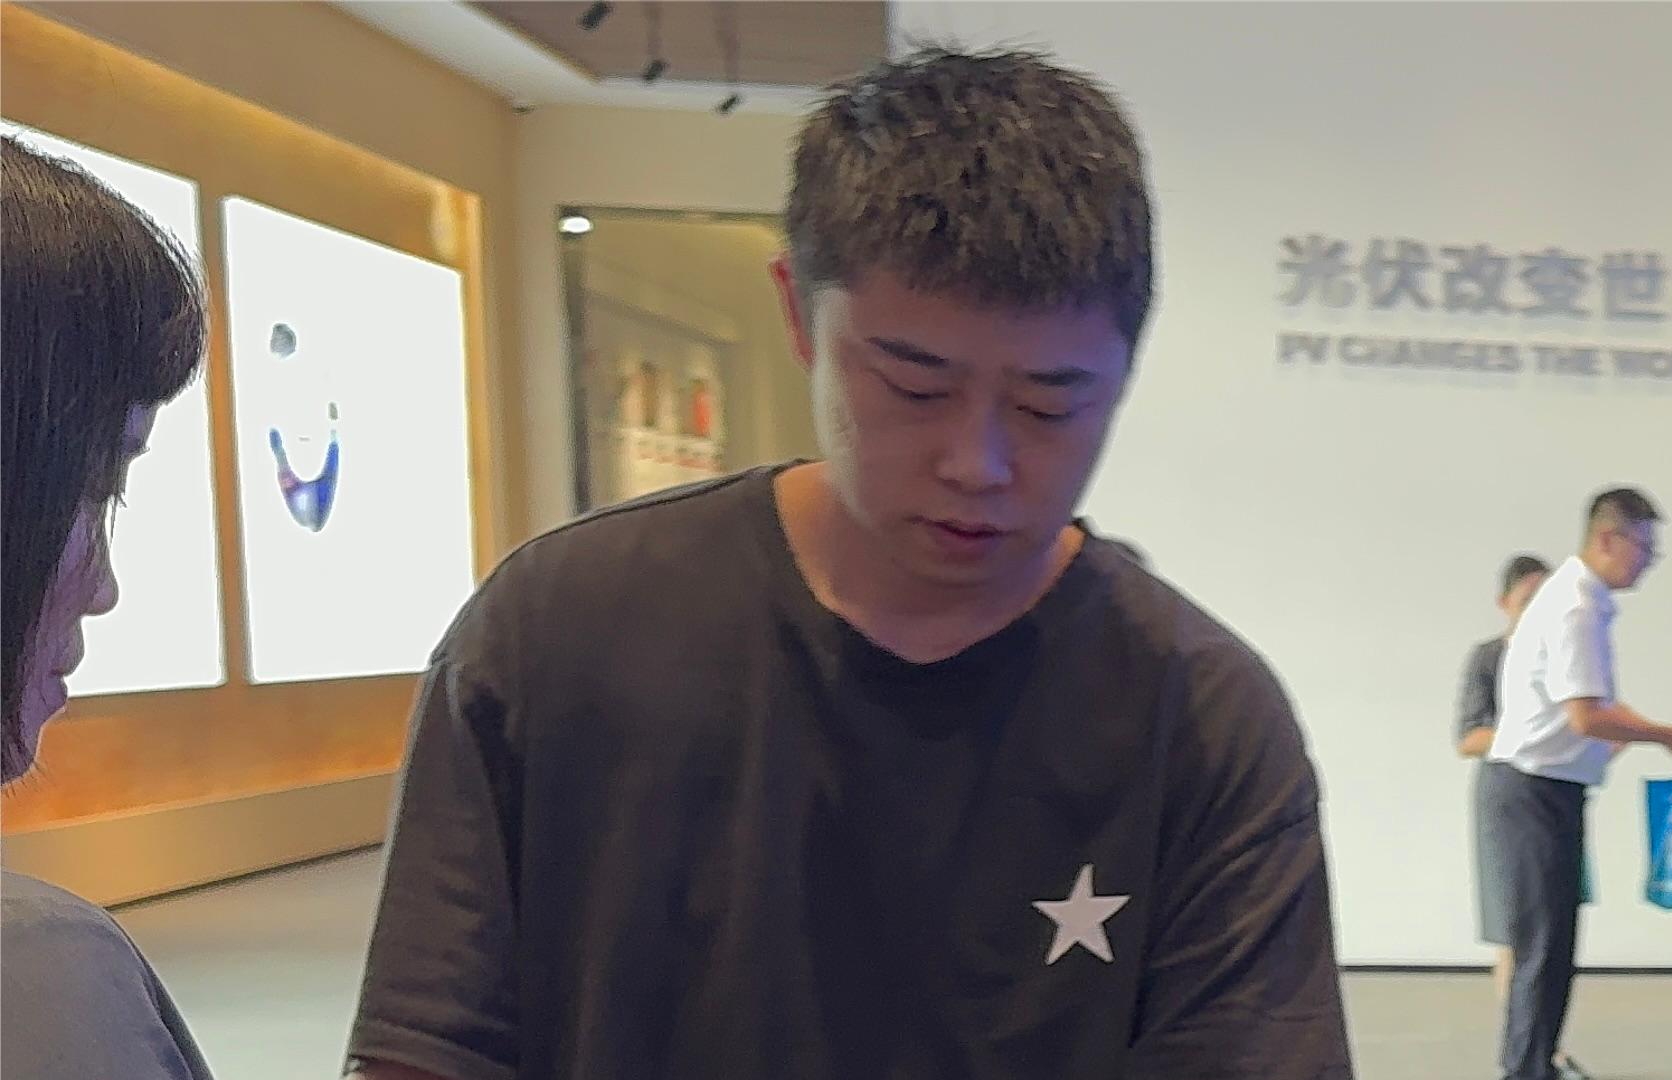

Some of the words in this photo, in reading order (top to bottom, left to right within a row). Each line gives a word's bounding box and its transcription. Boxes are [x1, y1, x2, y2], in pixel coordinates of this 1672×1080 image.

[1276, 331, 1331, 366] PV
[1338, 336, 1522, 375] CHANGES
[1531, 344, 1602, 377] THE
